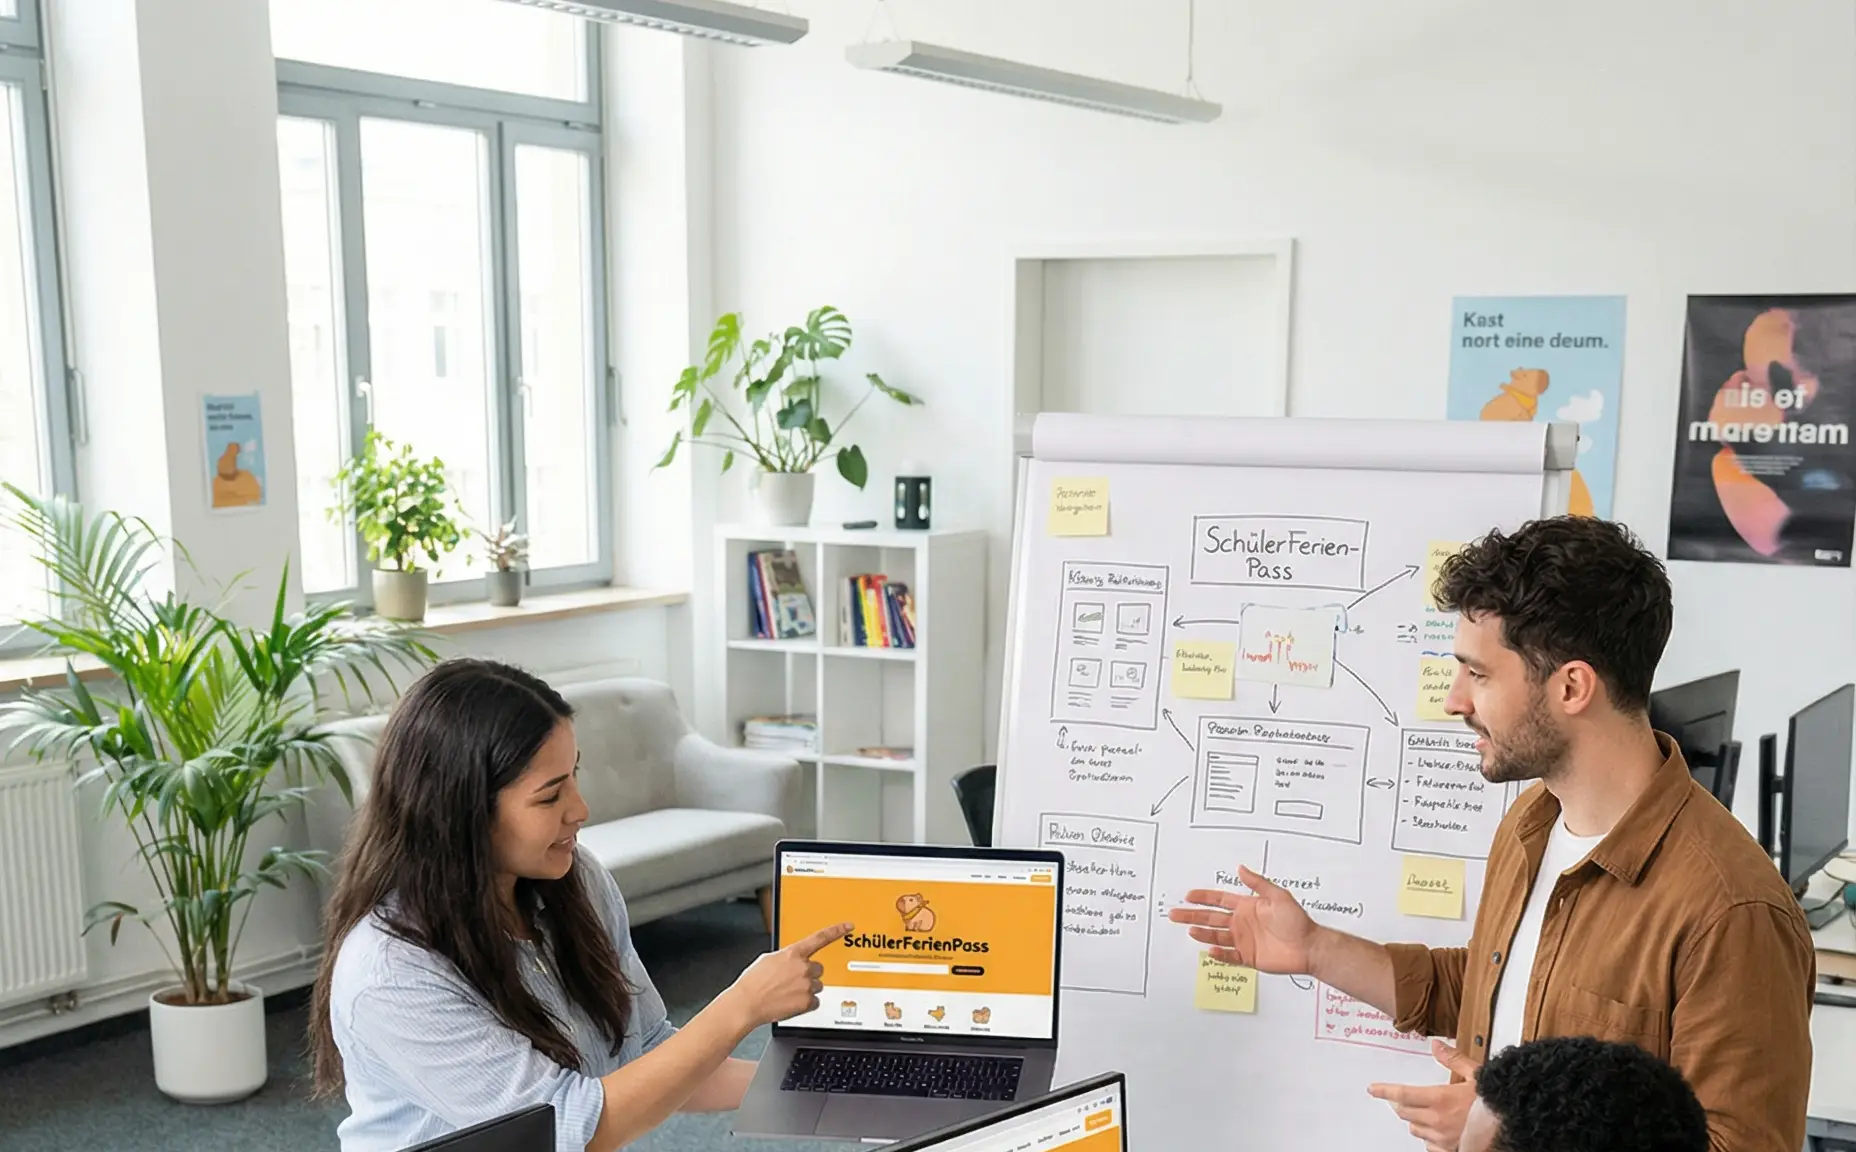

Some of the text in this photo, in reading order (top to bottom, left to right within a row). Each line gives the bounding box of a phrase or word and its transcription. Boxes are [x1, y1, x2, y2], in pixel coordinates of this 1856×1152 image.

[1462, 332, 1609, 349] nort eine deum.
[1203, 525, 1360, 556] SchülerFerien-
[1245, 556, 1293, 581] Pass
[843, 932, 990, 954] SchülerFerienPass
